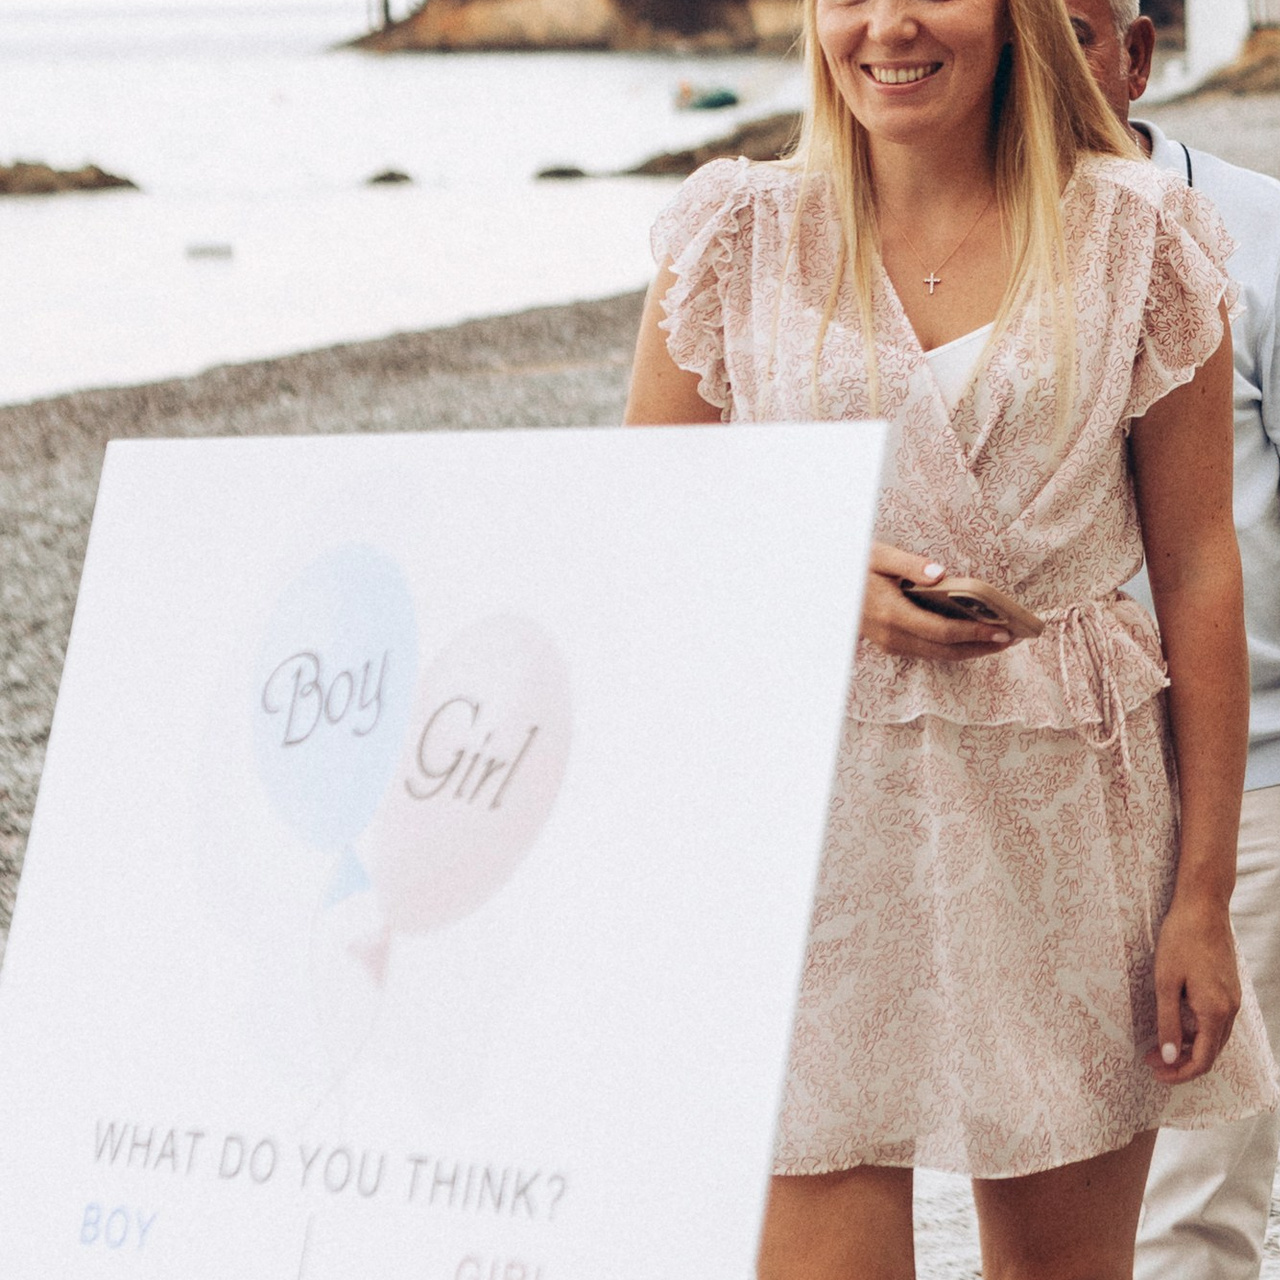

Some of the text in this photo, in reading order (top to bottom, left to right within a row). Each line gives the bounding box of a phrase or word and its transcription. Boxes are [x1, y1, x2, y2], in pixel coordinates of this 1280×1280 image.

[262, 650, 389, 746] Boy
[405, 697, 538, 809] Girl
[94, 1120, 567, 1218] WHAT DO YOU THINK?
[79, 1202, 157, 1248] BOY
